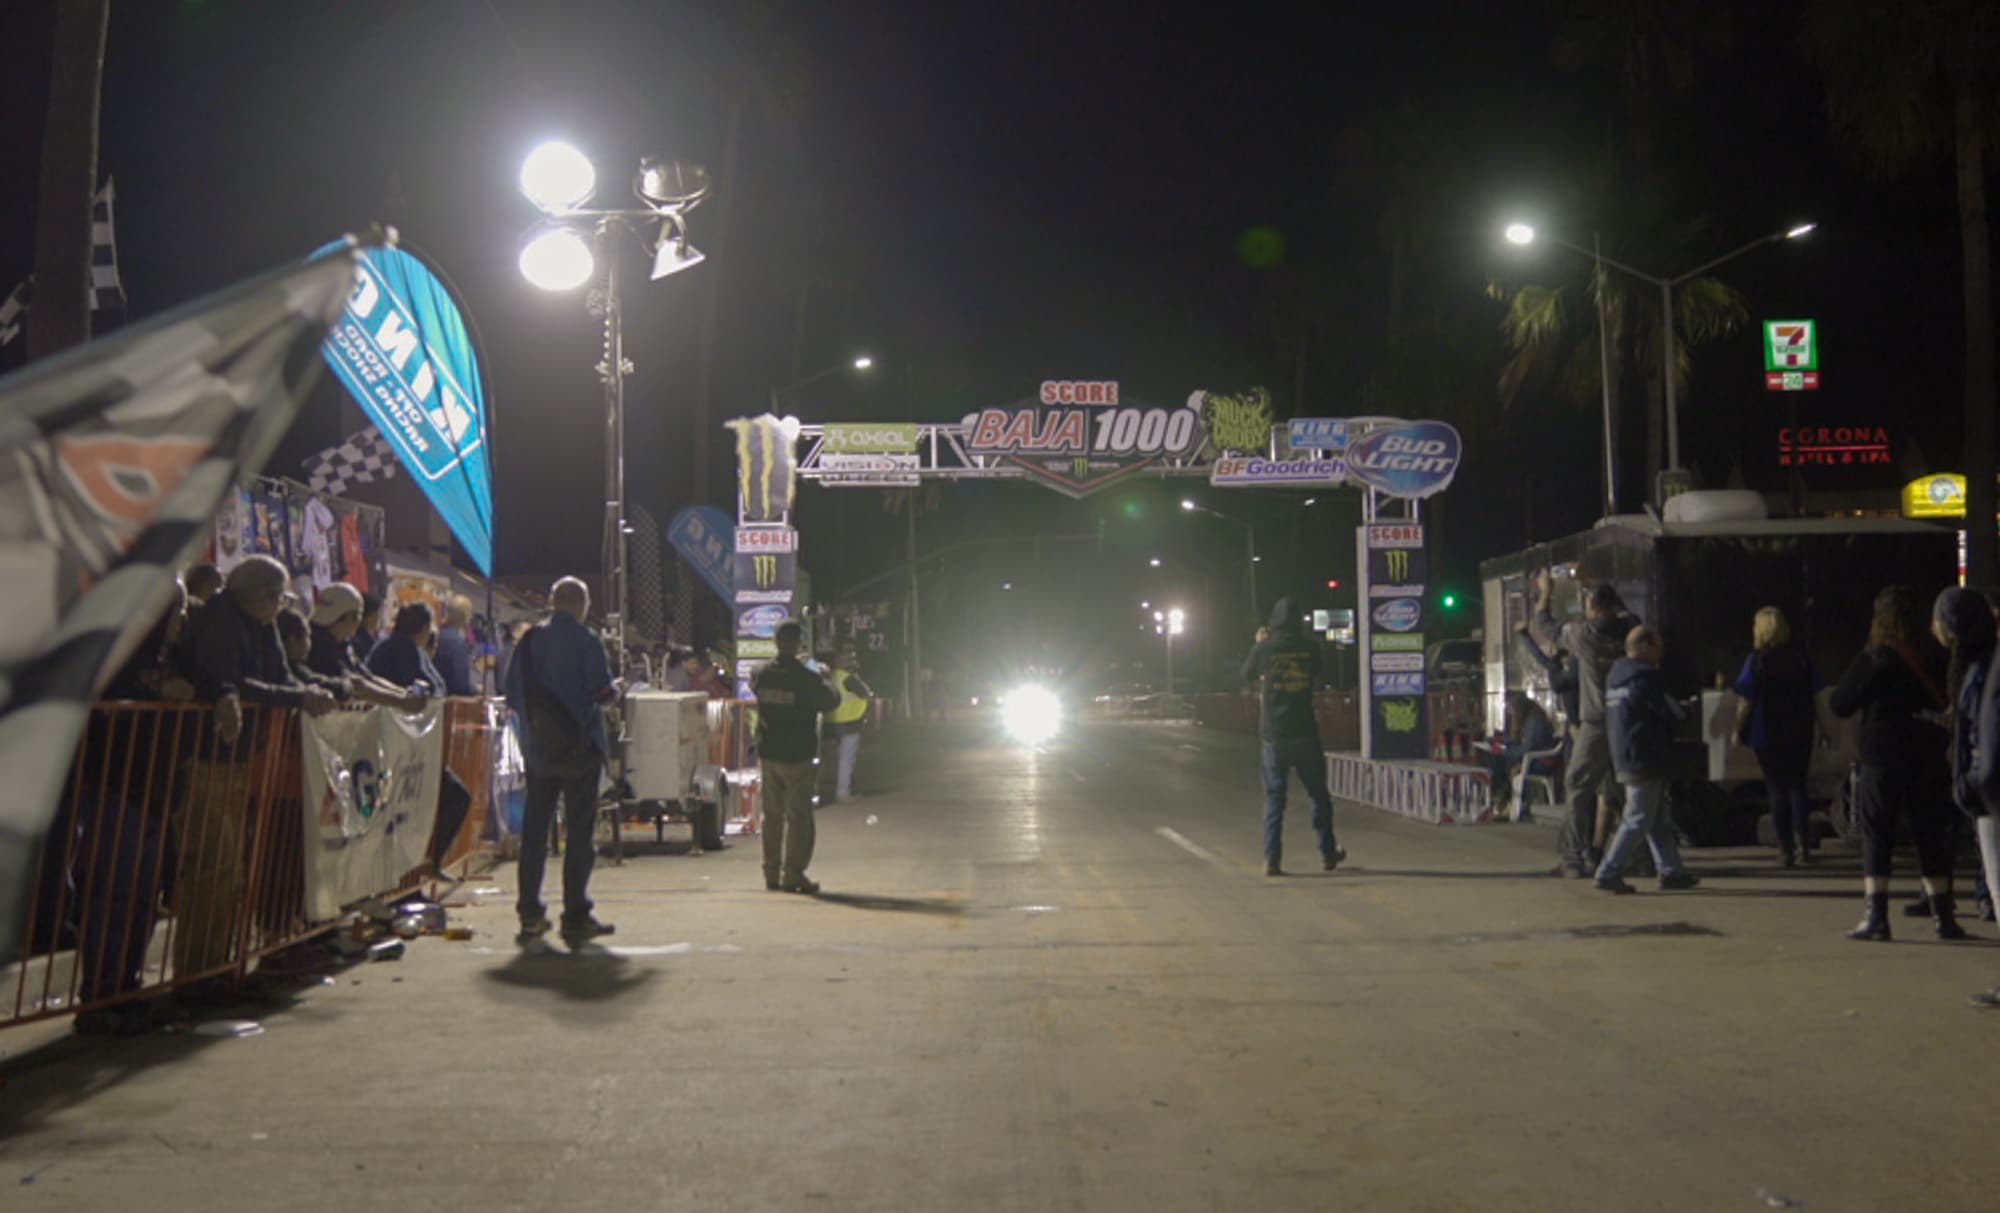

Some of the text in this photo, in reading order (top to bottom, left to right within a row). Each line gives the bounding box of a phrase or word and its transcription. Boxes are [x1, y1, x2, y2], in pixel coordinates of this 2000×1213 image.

[1775, 326, 1805, 366] 7
[1042, 381, 1118, 404] SCORE
[972, 407, 1194, 452] BAJA 1000
[1779, 427, 1889, 445] CORONA
[1380, 436, 1447, 455] BUD
[1216, 459, 1346, 476] BFGoodrich
[1364, 452, 1455, 474] LIGHT
[738, 532, 789, 545] SCORE
[1372, 526, 1420, 541] SCORE
